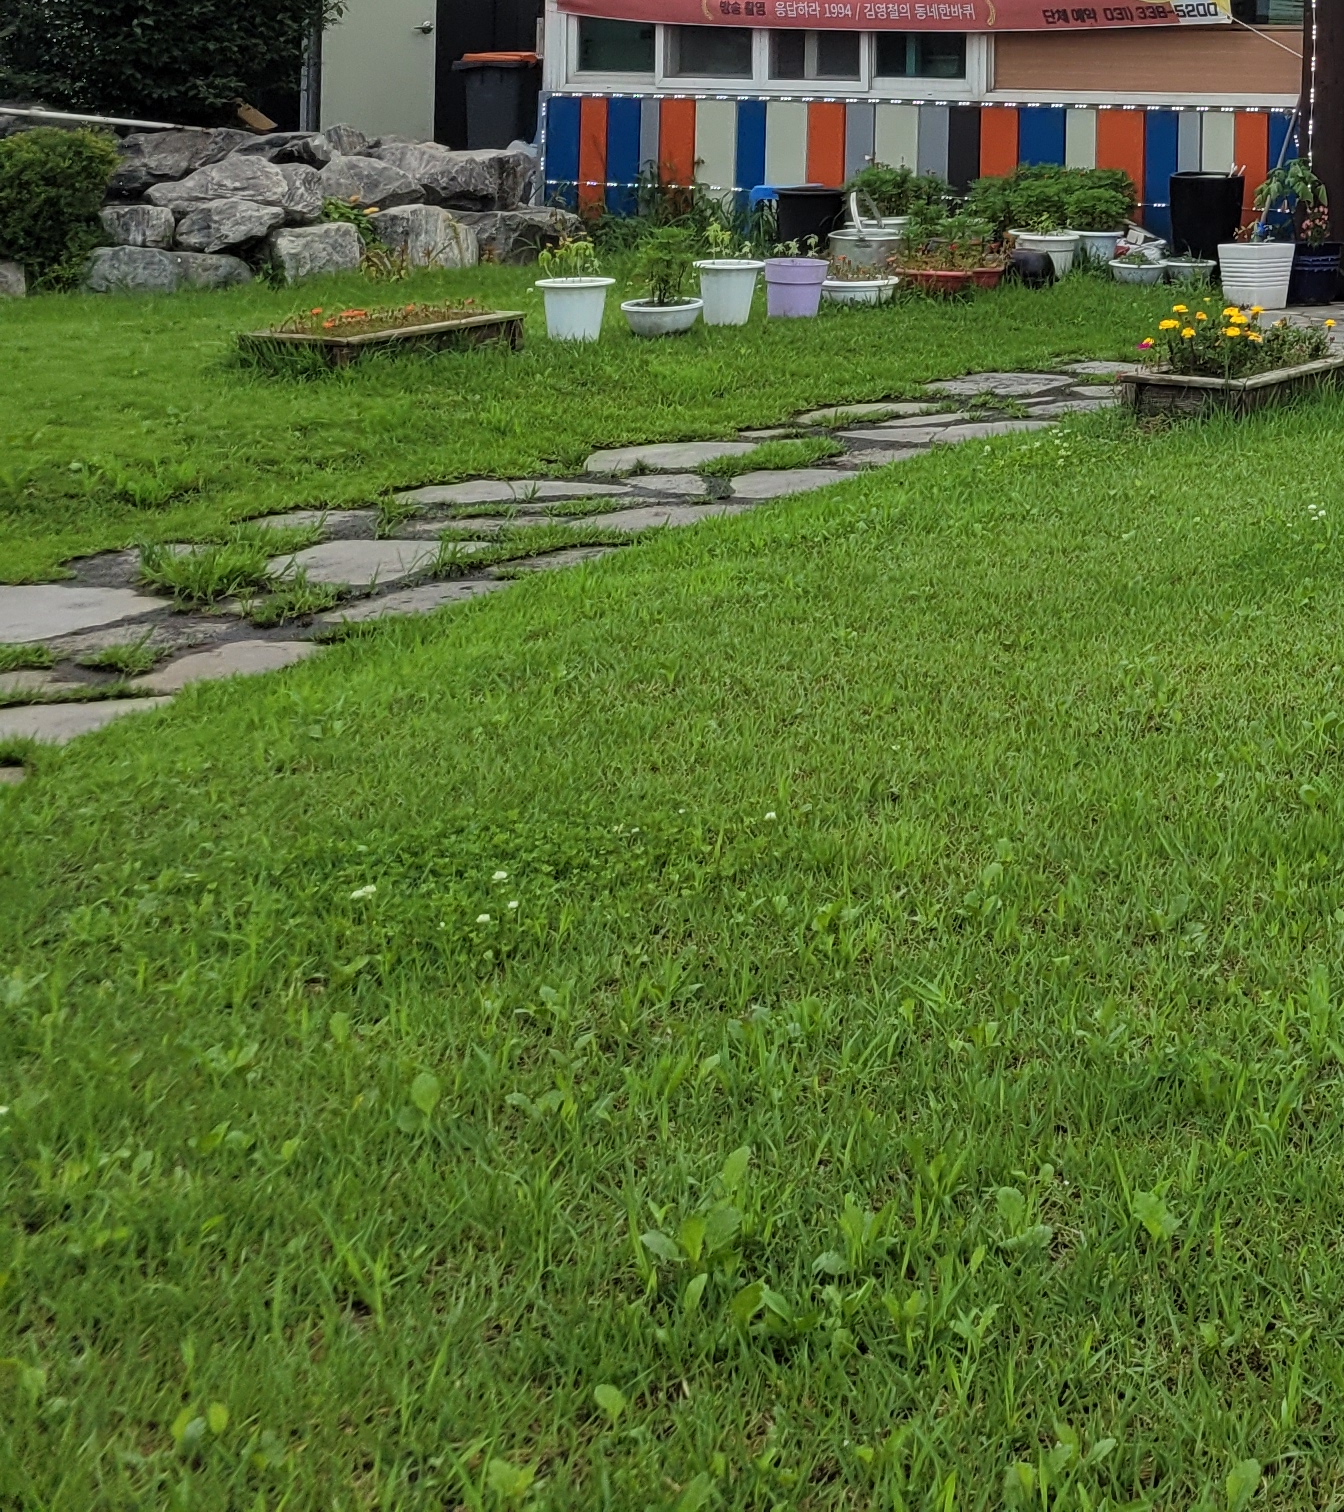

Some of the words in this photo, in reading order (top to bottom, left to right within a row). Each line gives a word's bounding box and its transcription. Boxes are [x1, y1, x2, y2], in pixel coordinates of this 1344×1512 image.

[719, 0, 741, 15] 방송
[775, 1, 820, 18] 응답하라
[824, 3, 852, 18] 1994
[863, 2, 911, 20] 김영철의
[914, 3, 976, 20] 동네한바퀴
[1042, 7, 1070, 25] 단체
[1103, 6, 1134, 22] 031)
[1135, 1, 1219, 22] 338-5200
